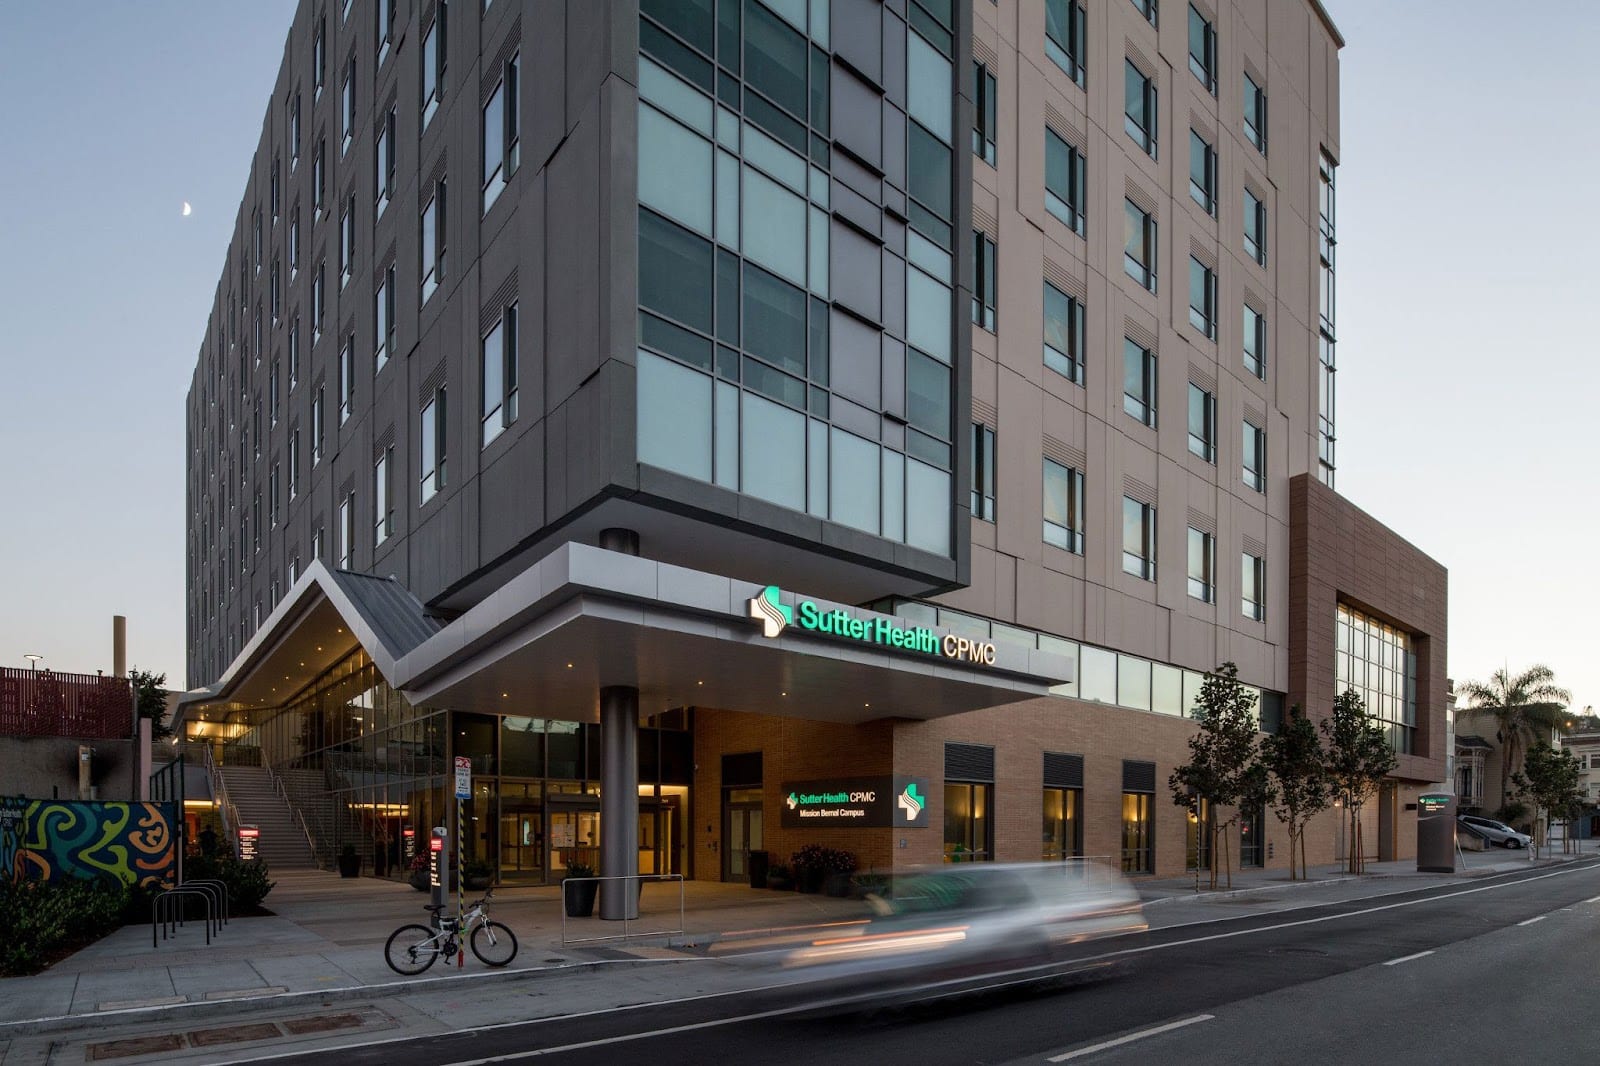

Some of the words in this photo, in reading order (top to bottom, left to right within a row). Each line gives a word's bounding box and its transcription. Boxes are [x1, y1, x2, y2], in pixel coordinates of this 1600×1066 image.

[799, 600, 873, 641] Sutter
[875, 617, 941, 655] Health
[943, 634, 996, 665] CPMC
[799, 793, 822, 804] Sutter
[823, 792, 849, 803] Health
[849, 791, 876, 803] CPMC
[799, 809, 820, 818] Mission
[820, 809, 840, 817] Bernal
[840, 808, 865, 818] Campus
